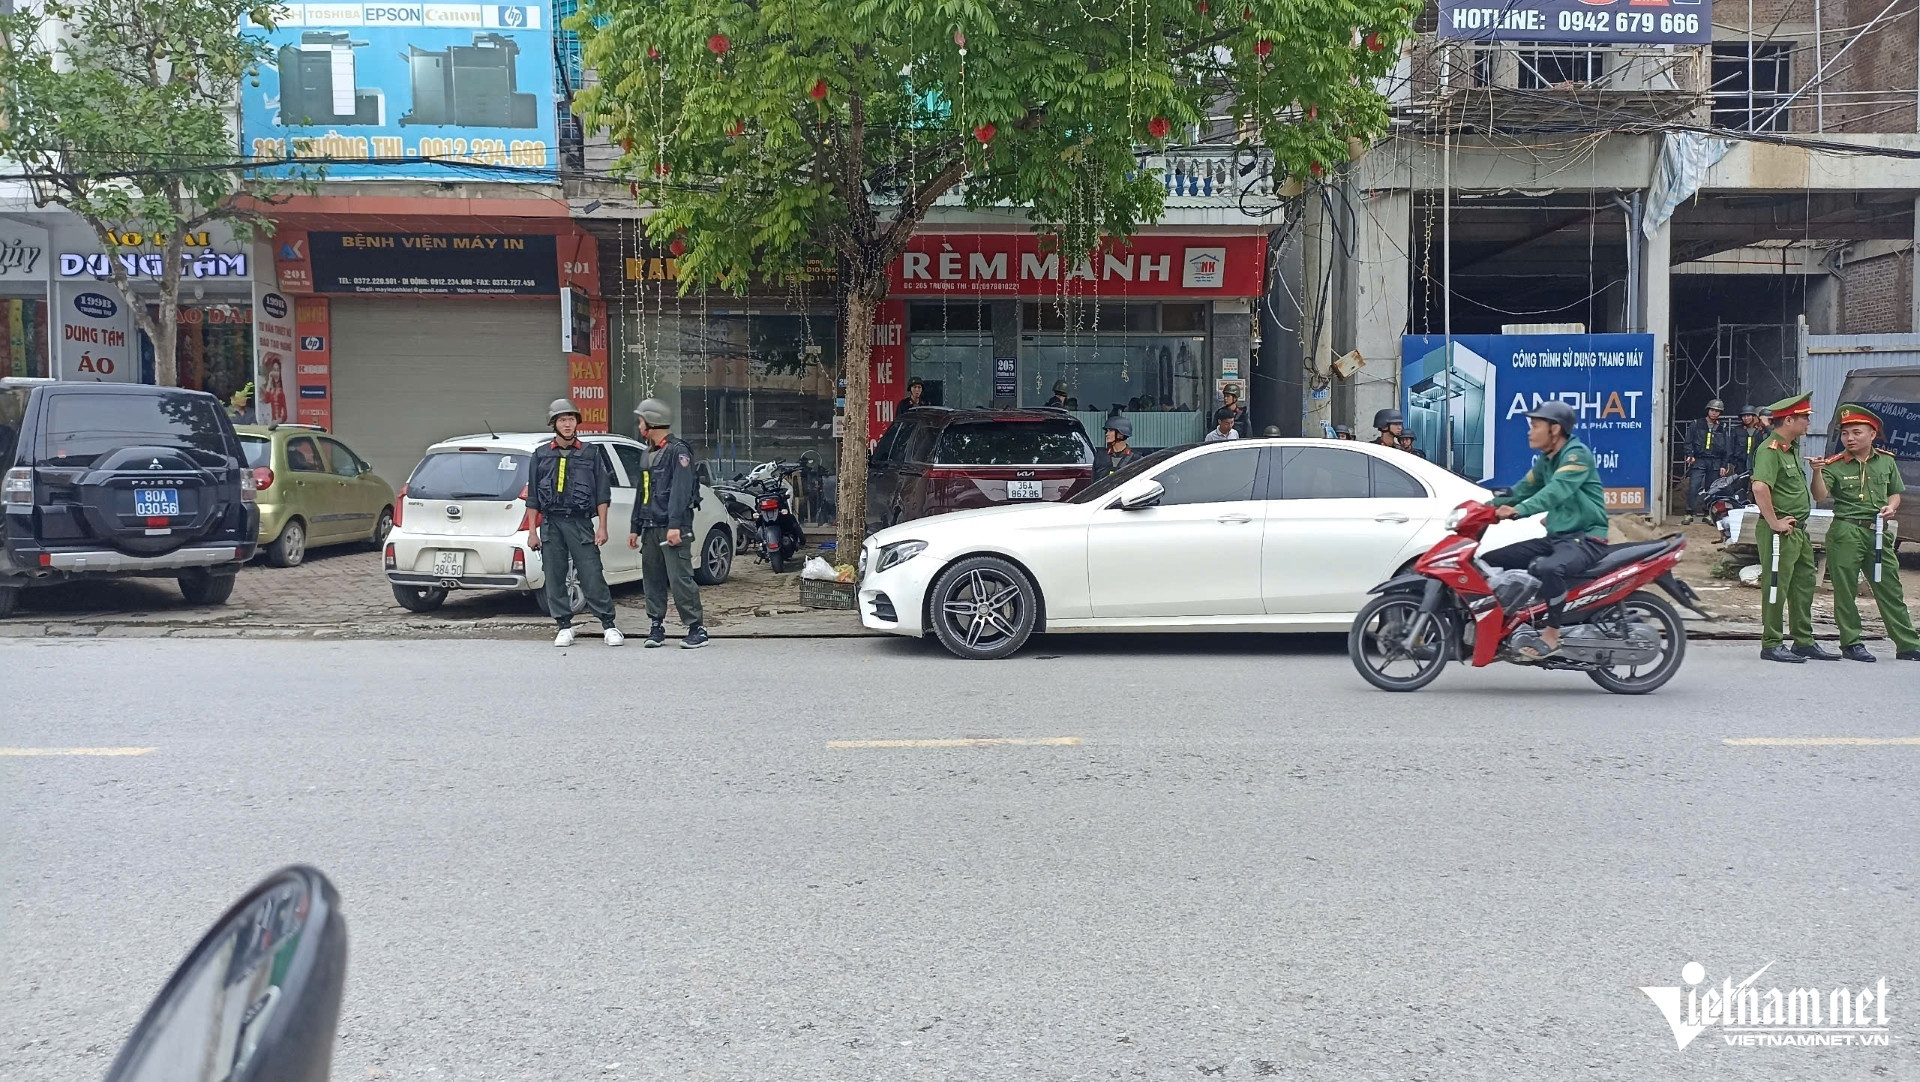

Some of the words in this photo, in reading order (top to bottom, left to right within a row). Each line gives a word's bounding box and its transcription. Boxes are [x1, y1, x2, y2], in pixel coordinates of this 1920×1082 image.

[308, 10, 361, 19] TOSHIBA
[366, 7, 421, 22] EPSON
[425, 8, 480, 22] Canon
[1453, 8, 1546, 30] HOTLINE:
[1559, 10, 1609, 31] 0942
[1616, 12, 1654, 32] 679
[1660, 13, 1699, 33] 666
[371, 137, 402, 160] THI
[420, 137, 546, 167] 0912.234.698
[342, 233, 395, 250] BỆNH
[401, 234, 447, 251] VIỆN
[453, 235, 498, 249] MÁY
[503, 238, 524, 250] IN
[564, 261, 590, 274] 201
[903, 243, 1008, 280] RÈM
[283, 269, 307, 279] 201
[80, 296, 112, 308] 199B
[65, 323, 98, 344] DUNG
[869, 318, 902, 345] THIẾT
[78, 350, 115, 375] ÁO
[997, 359, 1014, 371] 205
[1512, 348, 1537, 368] CÔNG
[1538, 348, 1561, 368] TRÌNH
[1573, 351, 1597, 372] DỤNG
[1598, 351, 1624, 367] THANG
[1626, 347, 1644, 367] MÁY
[877, 355, 893, 384] KẾ
[572, 386, 604, 399] PHOTO
[875, 400, 894, 422] THI
[144, 490, 168, 502] 80A
[1620, 491, 1642, 504] 666
[137, 502, 177, 515] 030.56
[441, 552, 457, 564] 36A
